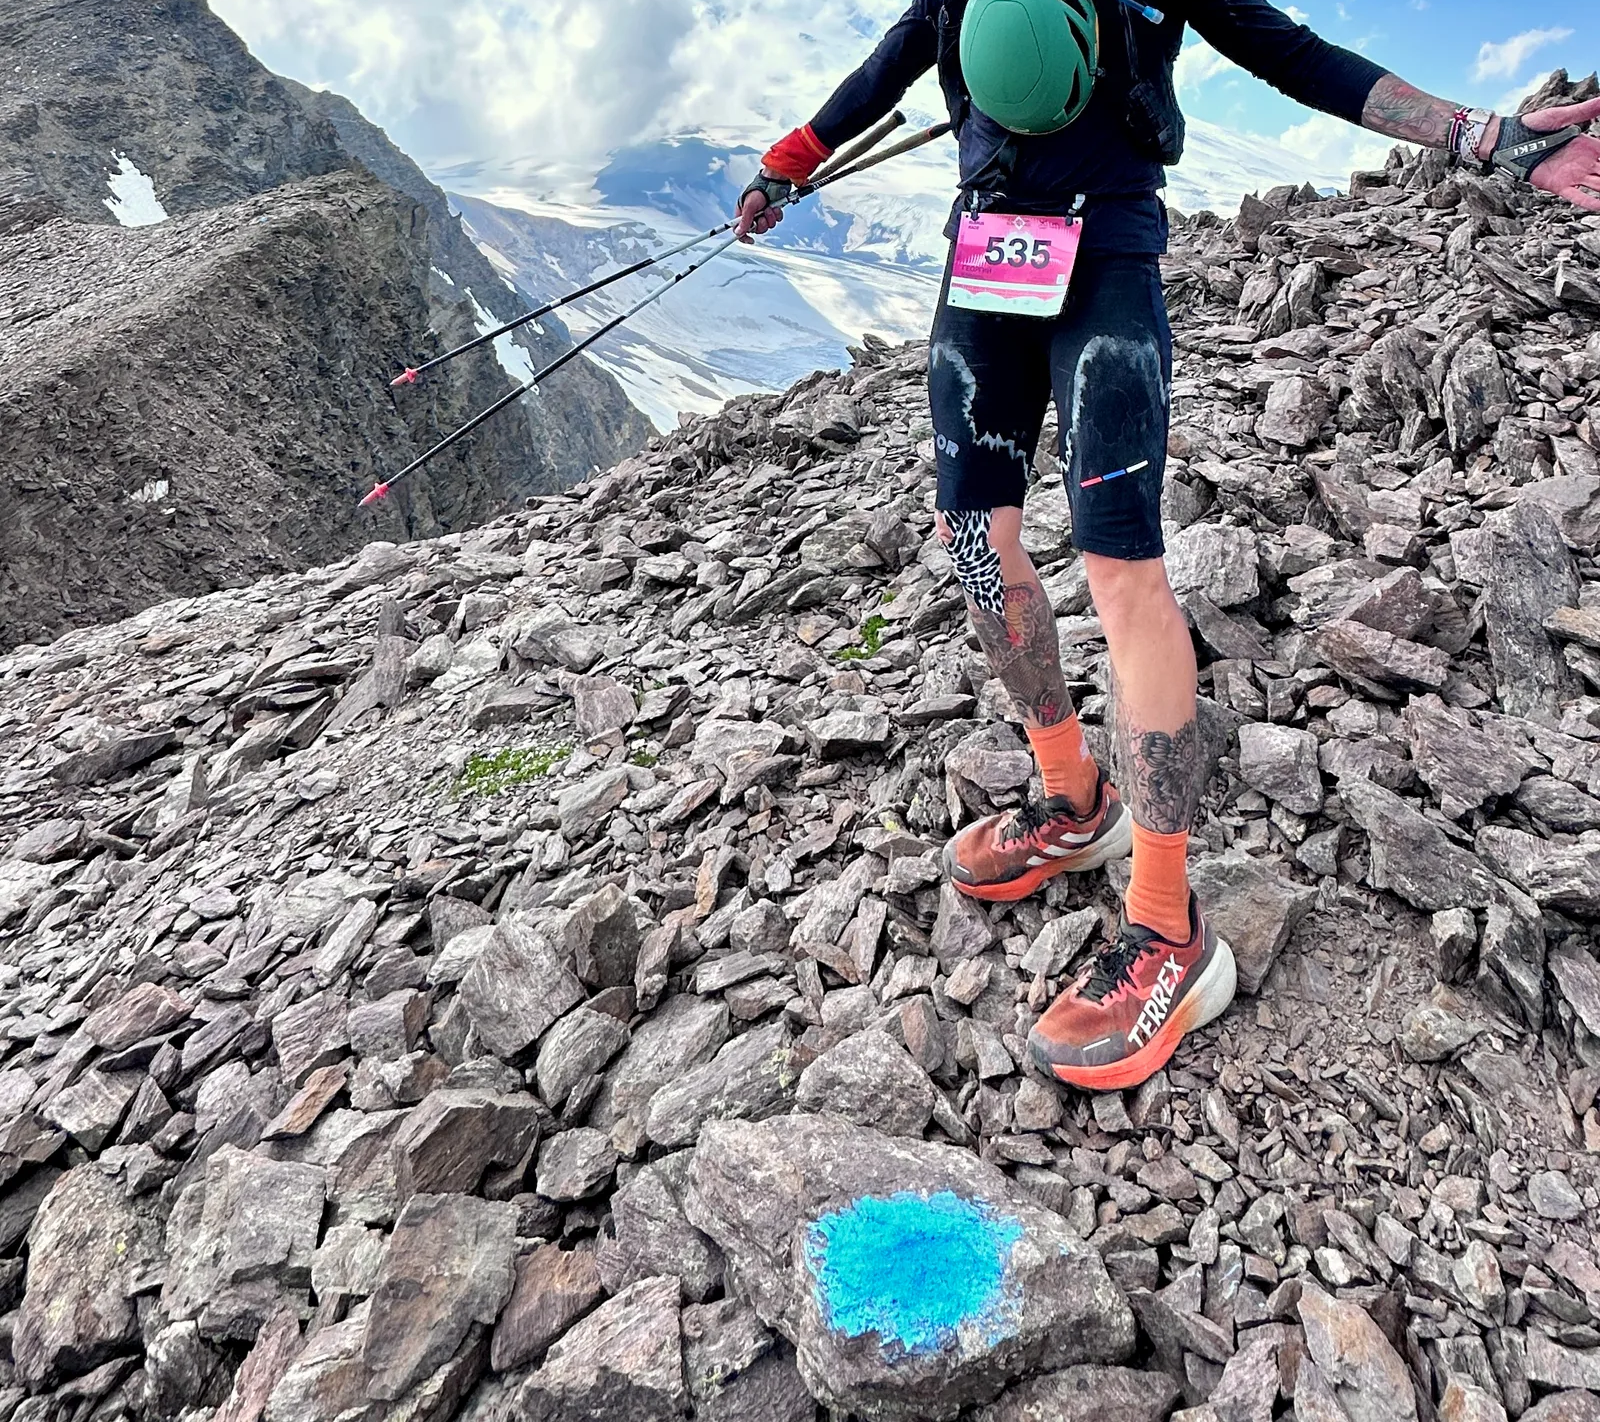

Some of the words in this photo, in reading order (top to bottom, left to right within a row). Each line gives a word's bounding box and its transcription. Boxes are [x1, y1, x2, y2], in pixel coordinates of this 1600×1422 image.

[1514, 140, 1547, 156] LEKI
[985, 237, 1052, 269] 535
[1127, 952, 1184, 1049] TERREX
